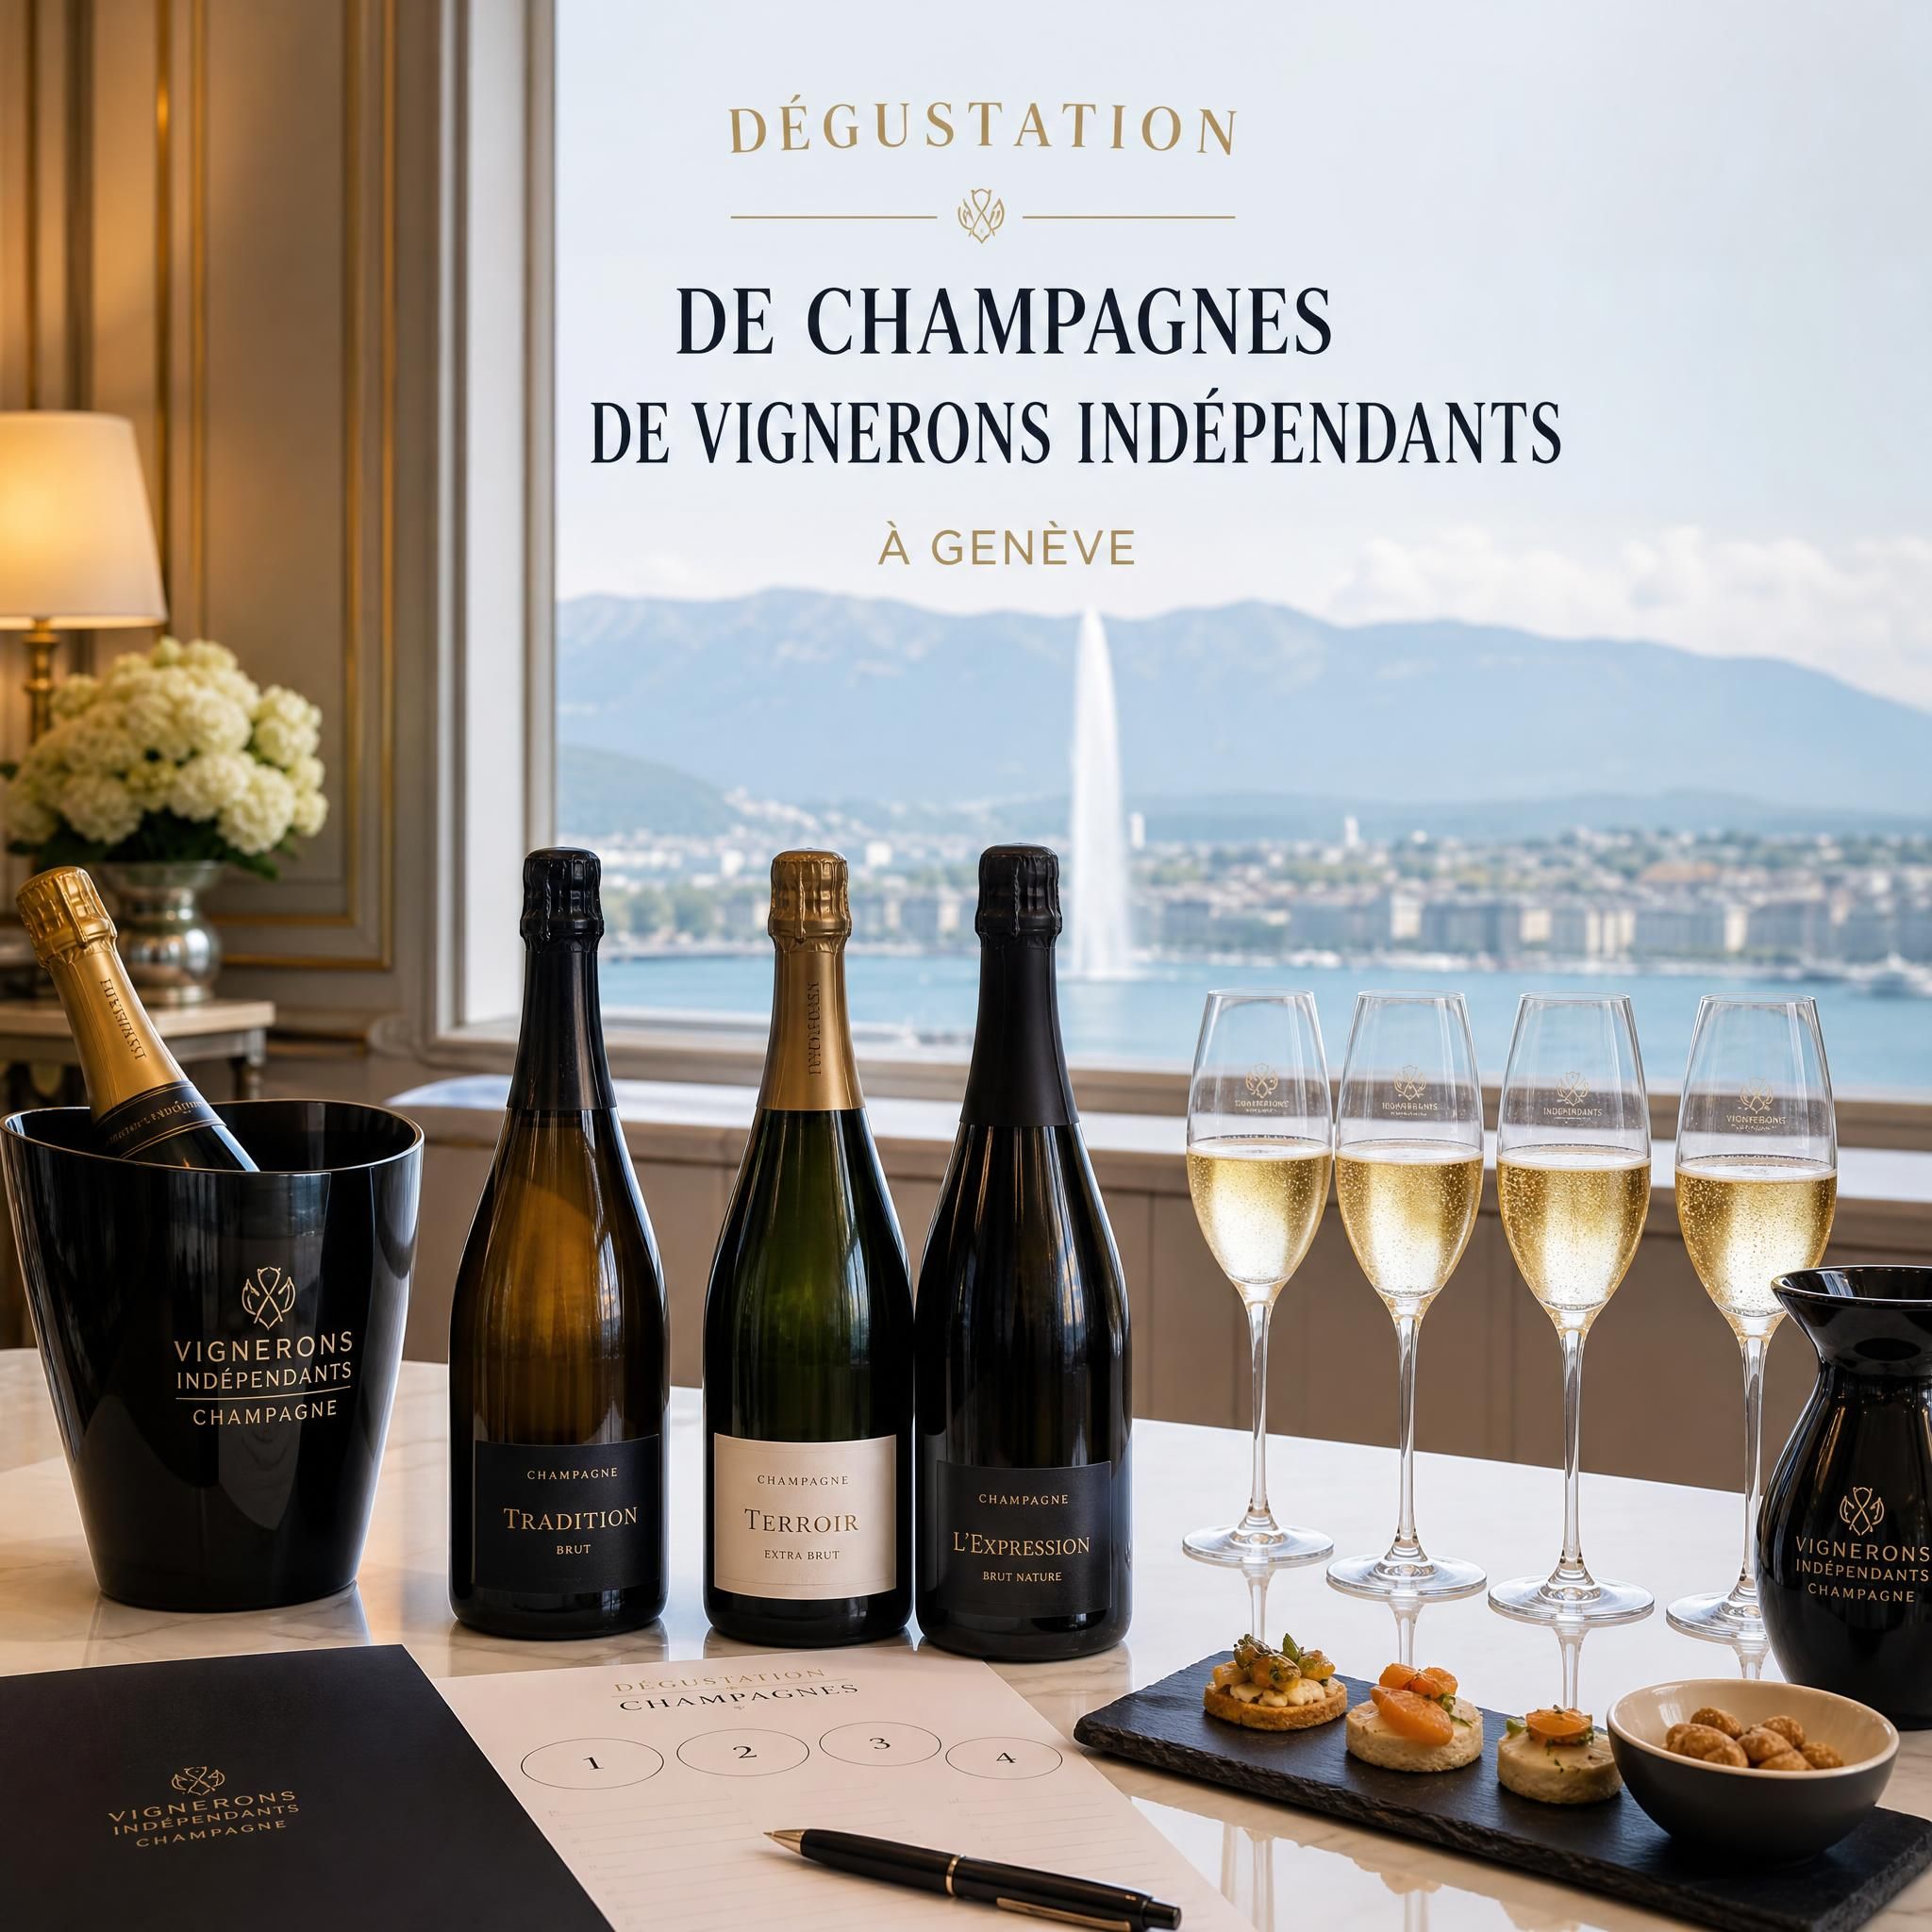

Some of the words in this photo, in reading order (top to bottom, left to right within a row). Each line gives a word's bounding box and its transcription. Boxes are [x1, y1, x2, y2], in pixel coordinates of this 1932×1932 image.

[174, 1331, 354, 1362] VIGNERONS
[176, 1361, 353, 1390] INDÉPENDANTS
[192, 1399, 338, 1425] CHAMPAGNE
[526, 1467, 619, 1480] CHAMPAGNE
[757, 1474, 850, 1487] CHAMPAGNE
[978, 1493, 1070, 1506] CHAMPAGNE
[503, 1507, 638, 1531] TRADITION
[744, 1508, 859, 1533] TERROIR
[557, 1543, 591, 1555] BRUT
[764, 1549, 803, 1560] EXTRA
[808, 1550, 841, 1560] BRUT
[1795, 1536, 1931, 1562] VIGNERONS
[983, 1571, 1013, 1582] BRUT
[1016, 1572, 1063, 1582] NATURE
[1795, 1558, 1930, 1582] INDÉPENDANTS
[1807, 1583, 1916, 1603] CHAMPAGNE
[613, 1669, 825, 1692] DÉGUSTATION
[619, 1684, 859, 1711] CHAMPAGNES
[732, 1745, 758, 1759] 2
[869, 1737, 891, 1751] 3
[582, 1757, 604, 1771] 1
[995, 1752, 1017, 1765] 4
[108, 1790, 296, 1823] VIGNERONS
[113, 1804, 300, 1836] INDÉPENDANTS
[136, 1820, 288, 1848] CHAMPAGNE
